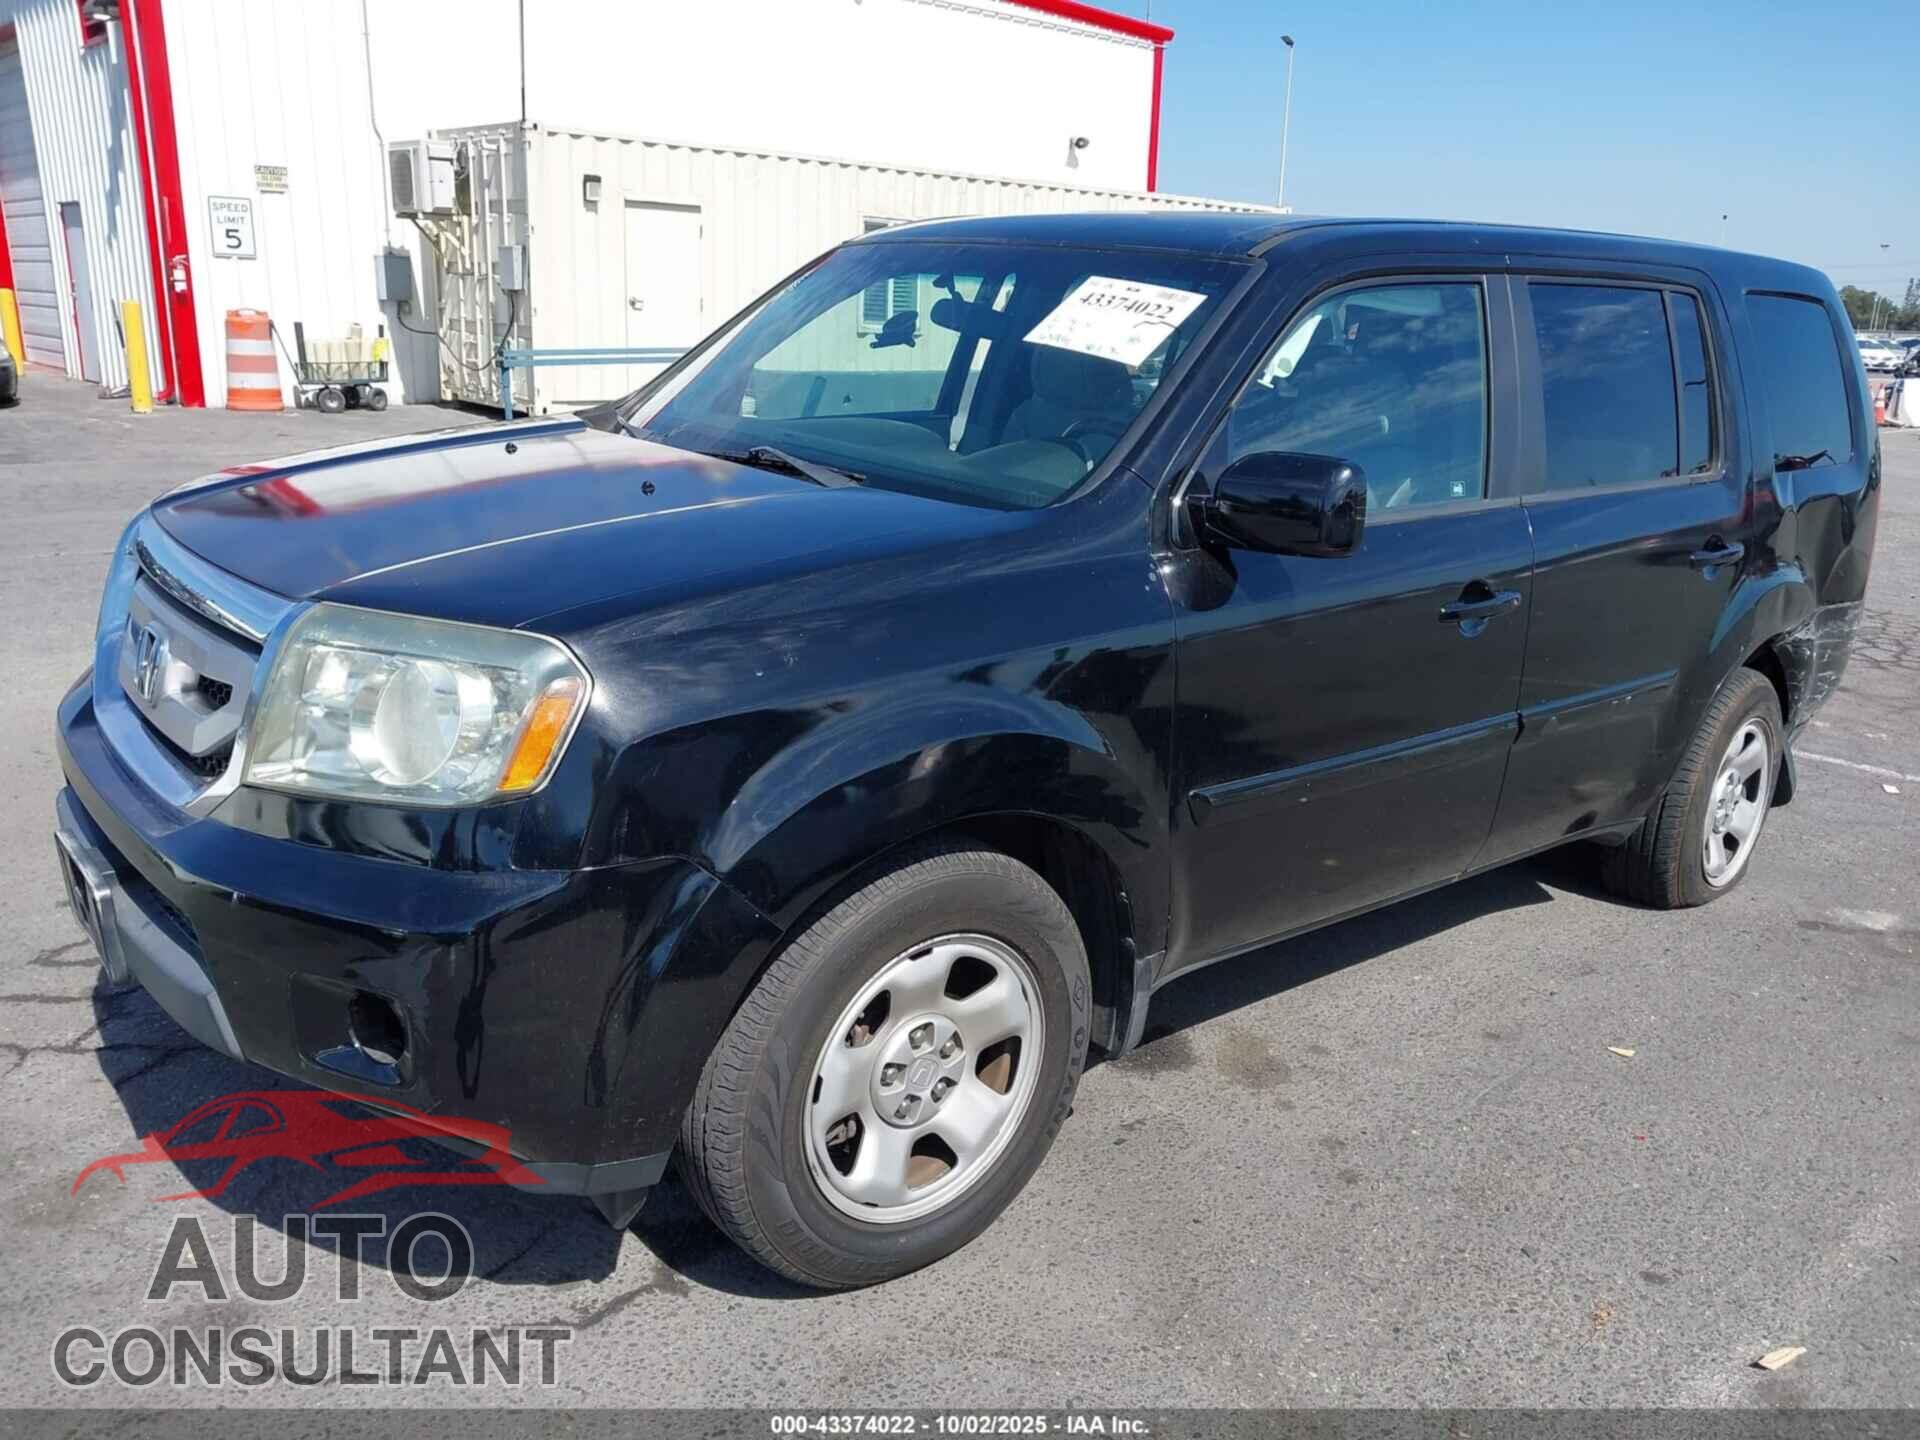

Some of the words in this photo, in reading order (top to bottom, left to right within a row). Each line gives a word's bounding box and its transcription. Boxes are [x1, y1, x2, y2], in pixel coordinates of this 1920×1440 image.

[212, 202, 248, 213] SPEED
[217, 216, 246, 225] LIMIT
[225, 228, 242, 249] 5
[1080, 291, 1174, 319] 43374022
